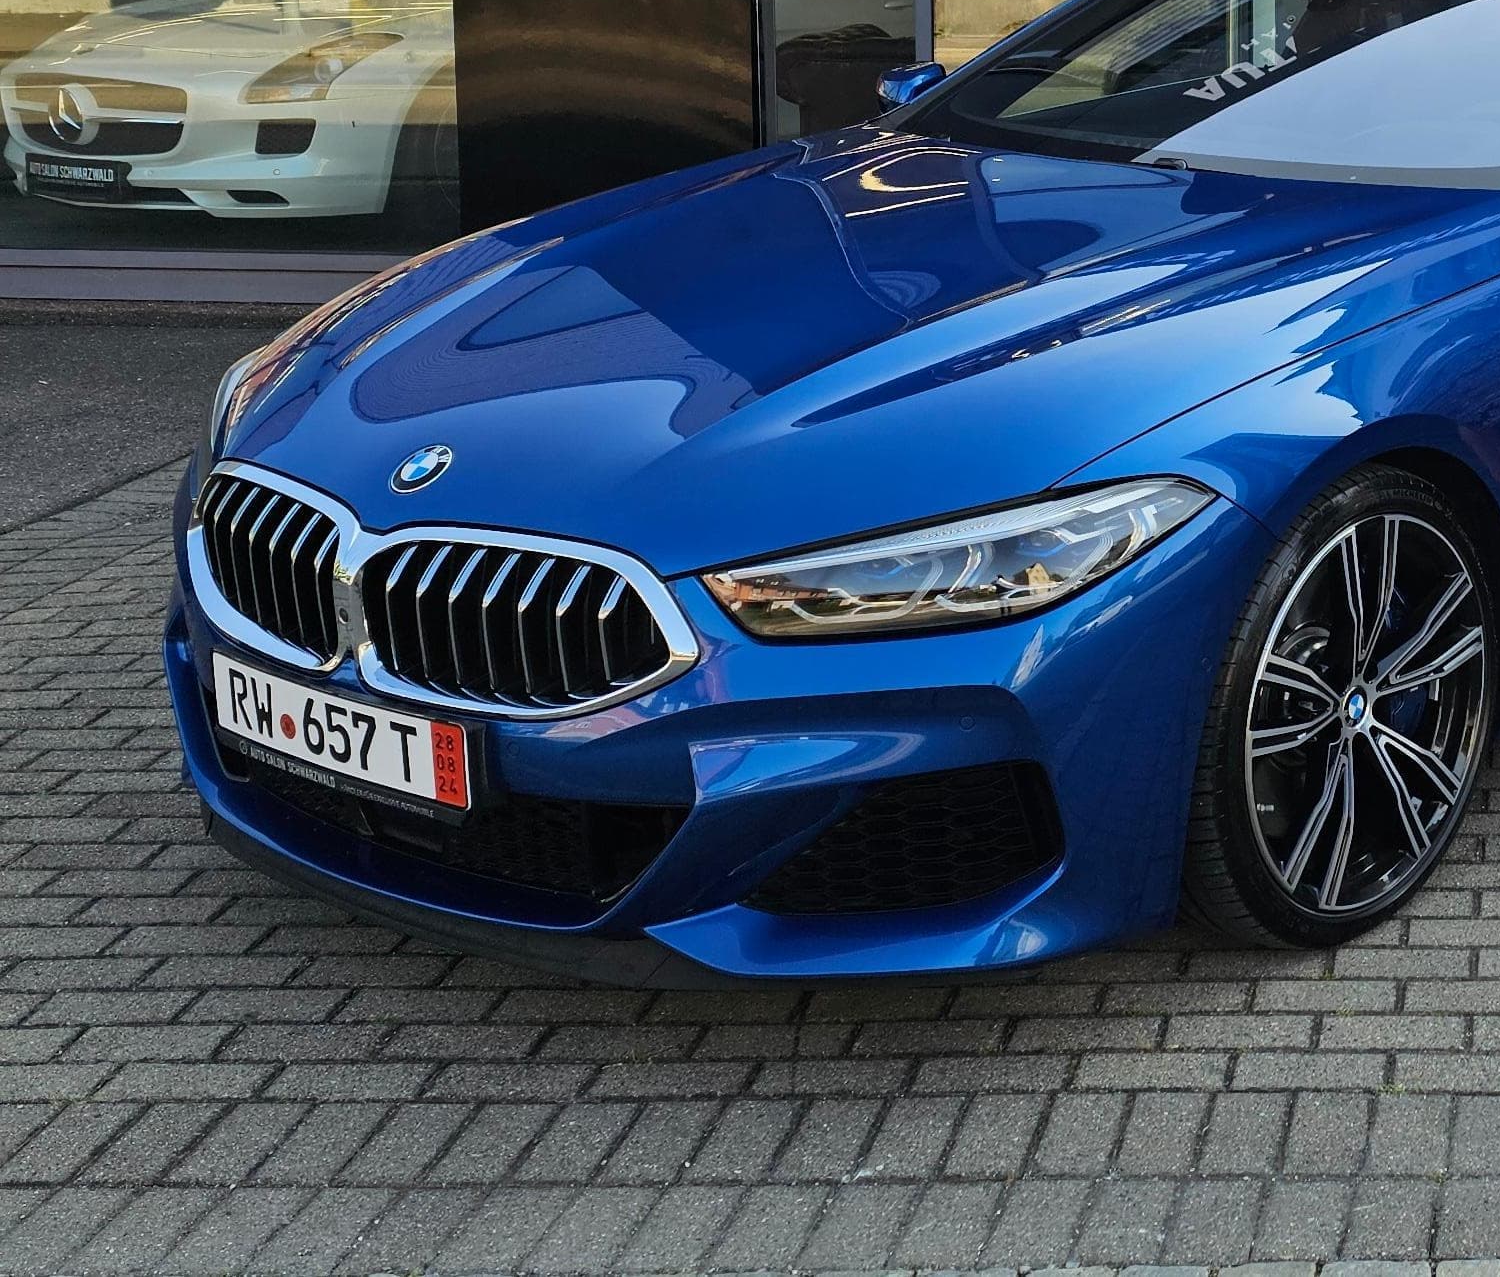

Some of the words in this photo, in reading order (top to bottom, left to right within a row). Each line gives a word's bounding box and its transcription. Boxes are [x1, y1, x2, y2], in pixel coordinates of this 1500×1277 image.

[229, 668, 273, 739] RW
[302, 697, 376, 771] 657
[390, 720, 418, 783] T
[435, 732, 454, 752] 28
[437, 753, 456, 773] 08
[438, 775, 458, 795] 24
